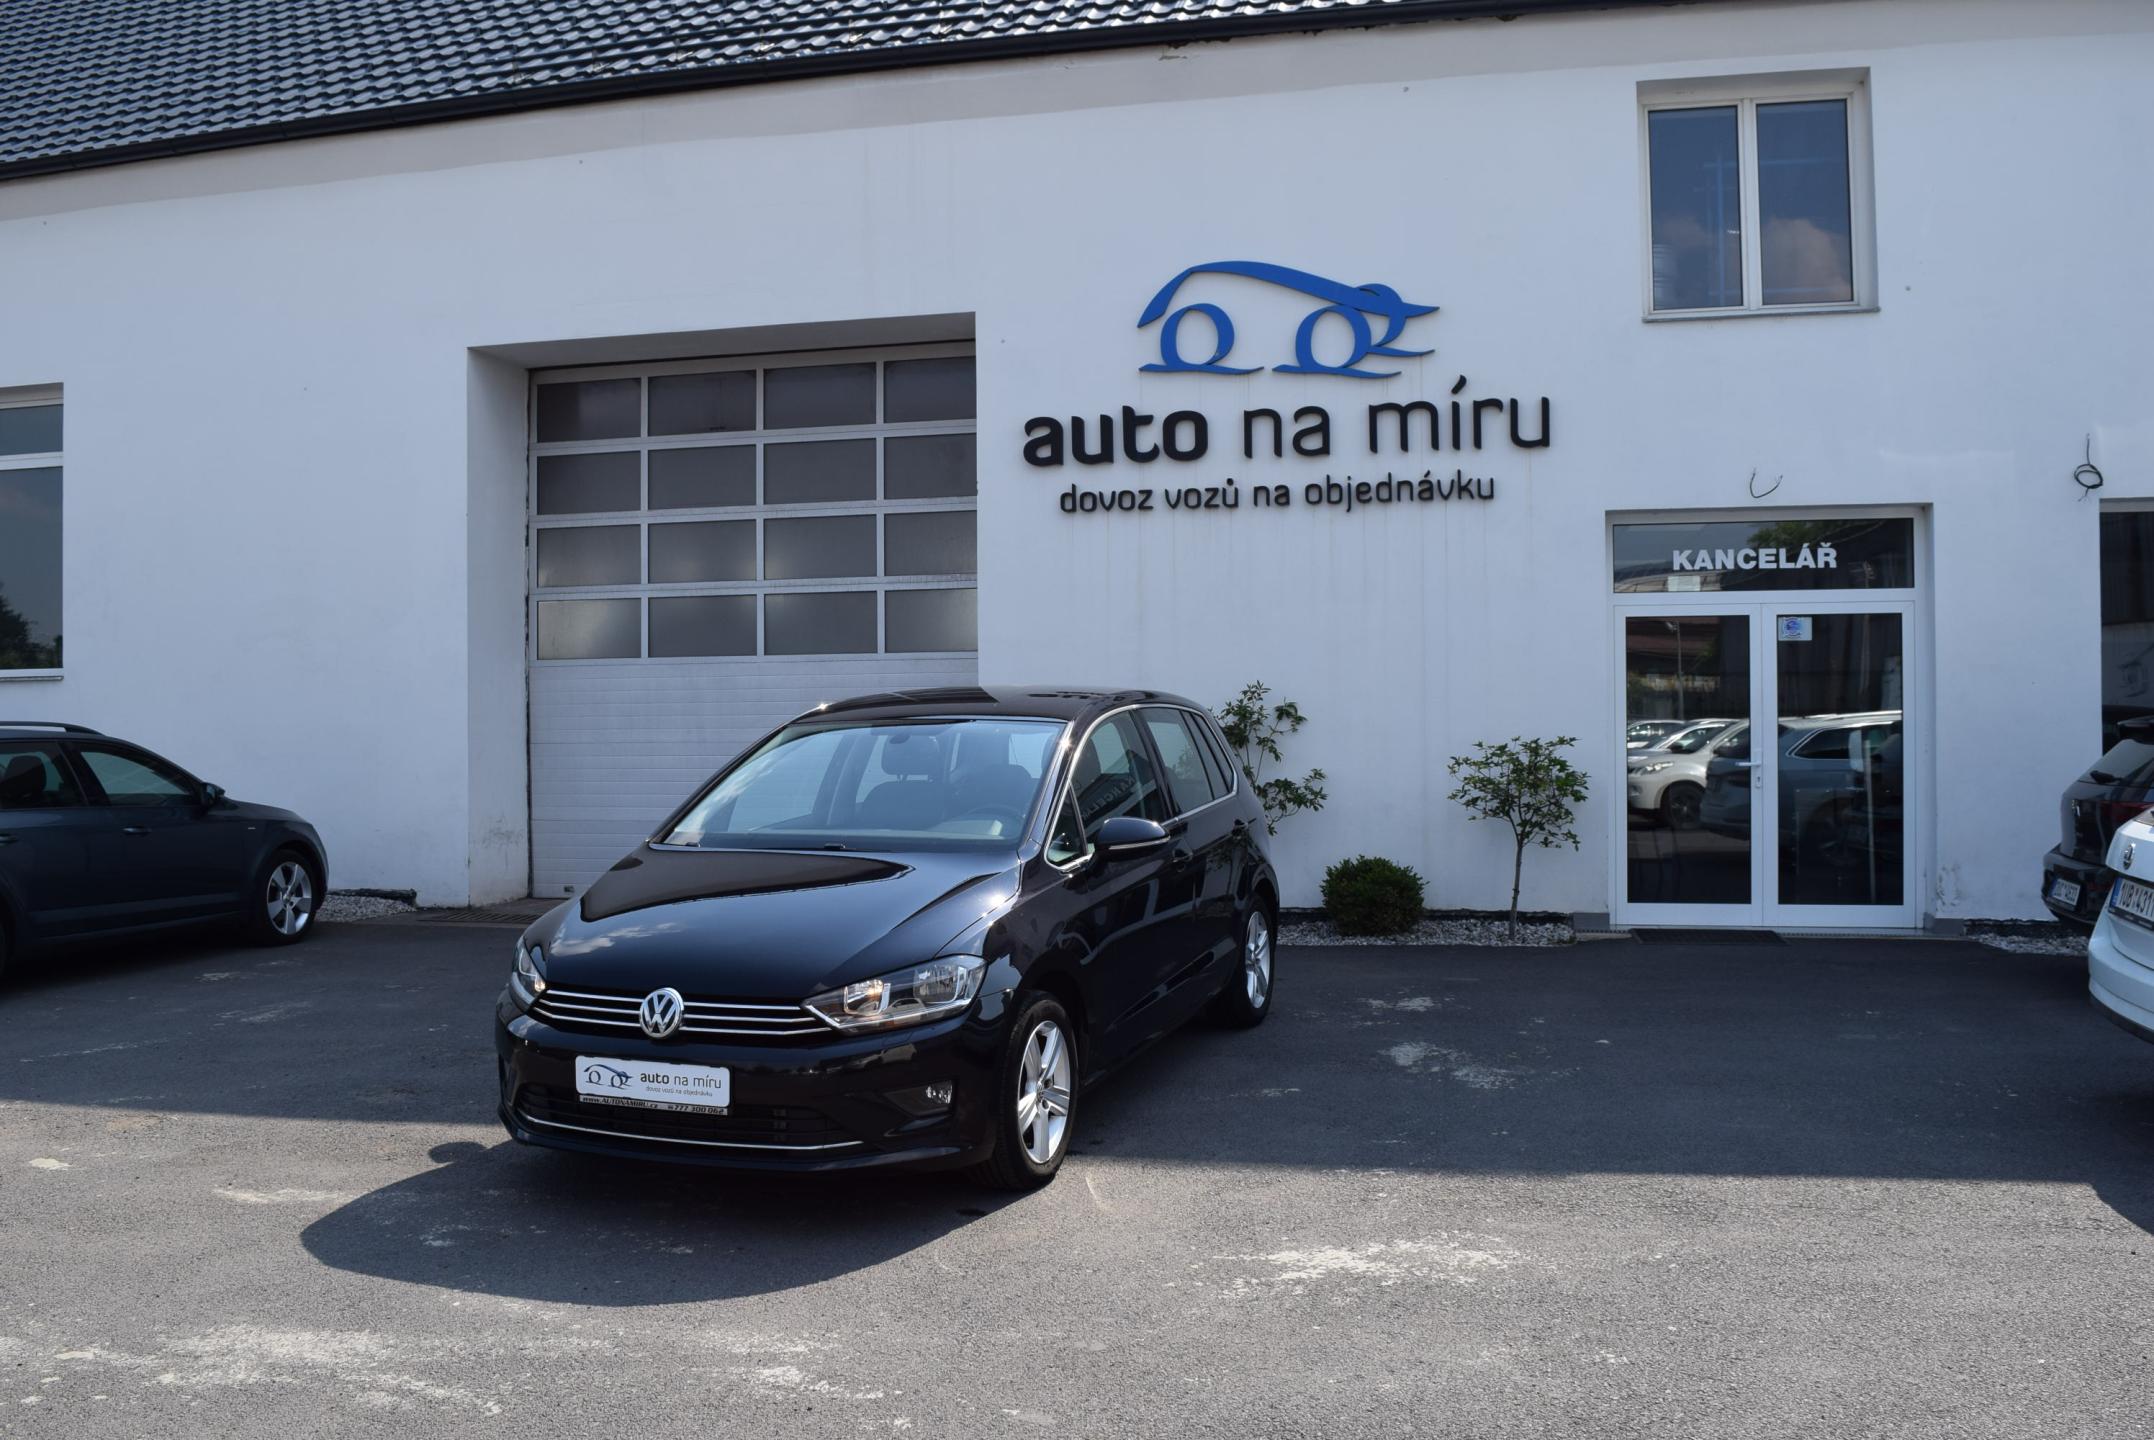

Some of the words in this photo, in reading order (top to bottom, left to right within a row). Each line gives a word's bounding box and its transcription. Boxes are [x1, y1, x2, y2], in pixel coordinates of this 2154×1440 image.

[1022, 405, 1209, 469] auto
[1243, 405, 1332, 460] na
[1368, 374, 1551, 454] míru
[1060, 483, 1154, 514] dovoz
[1164, 476, 1240, 512] vozů
[1253, 484, 1291, 508] na
[1304, 470, 1495, 513] objednávku
[1673, 542, 1838, 571] KANCELÁŘ
[641, 990, 681, 1036] VW
[640, 1072, 670, 1085] auto
[673, 1075, 689, 1086] na
[693, 1074, 722, 1089] míru
